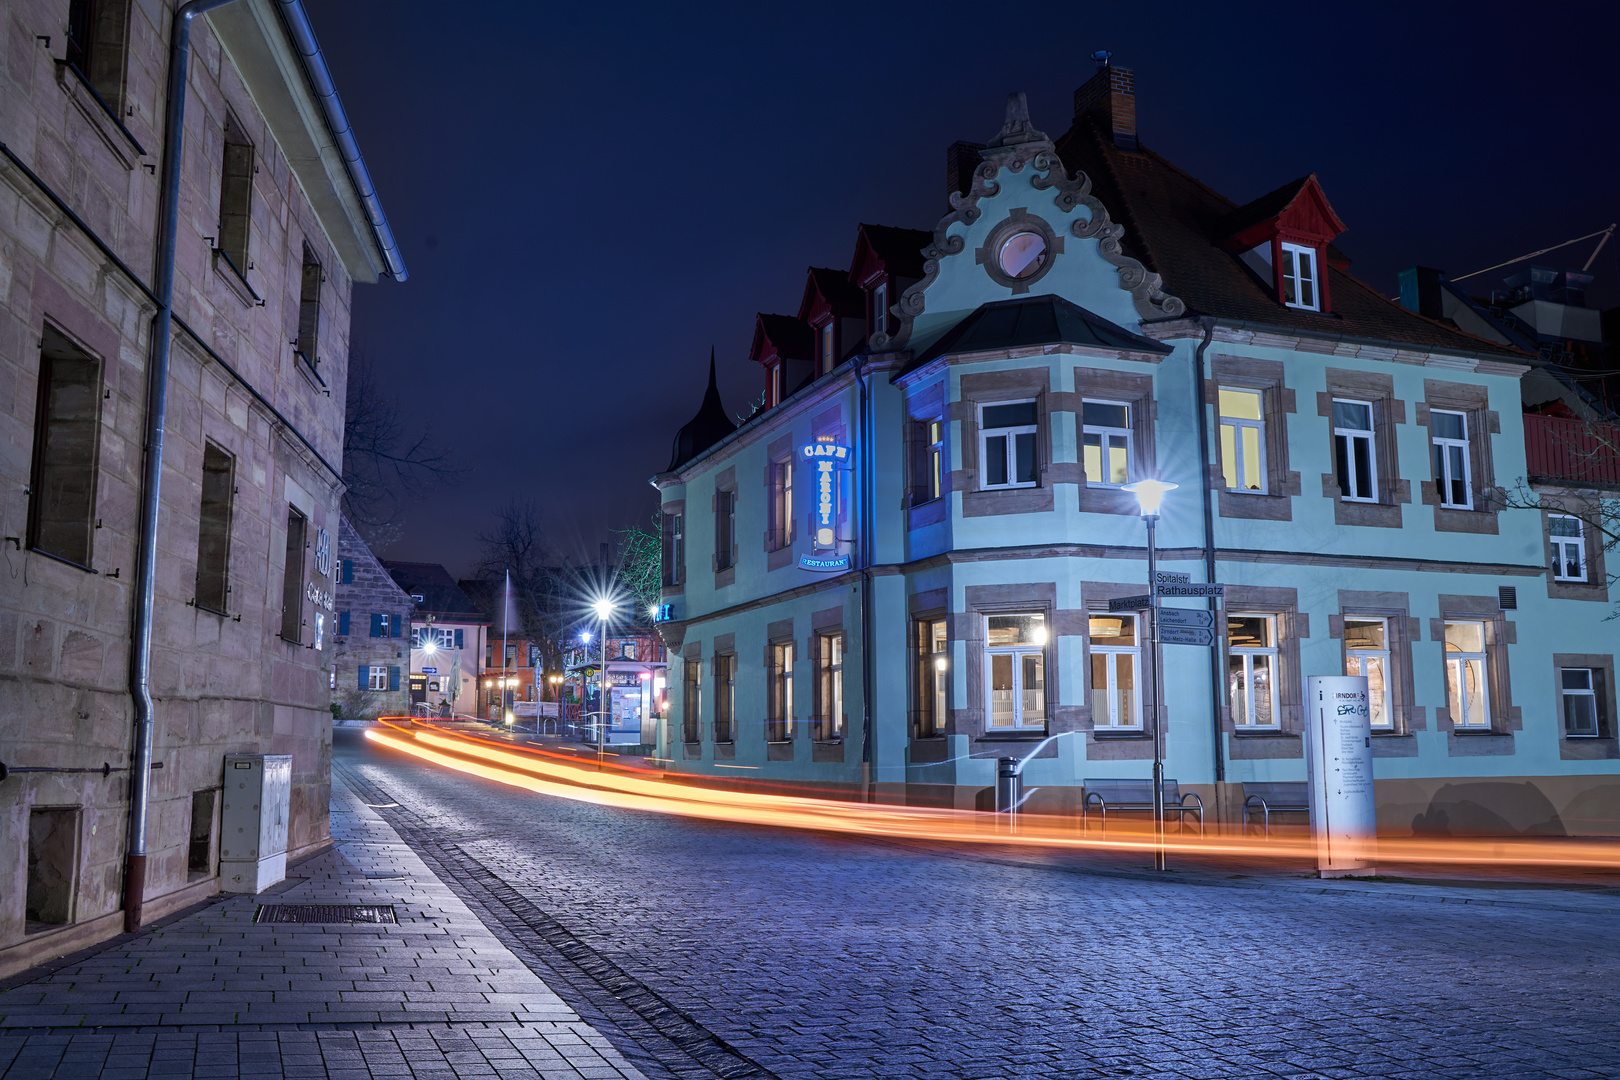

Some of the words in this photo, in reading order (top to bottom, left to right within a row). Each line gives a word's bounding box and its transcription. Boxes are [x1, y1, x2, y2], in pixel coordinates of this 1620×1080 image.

[804, 444, 847, 459] CAFE
[817, 461, 833, 525] MARONI
[801, 556, 849, 568] RESTAURANT
[1156, 572, 1190, 584] Spitalstr.
[1157, 585, 1223, 597] Rathausplatz
[1109, 597, 1149, 611] Marktplatz
